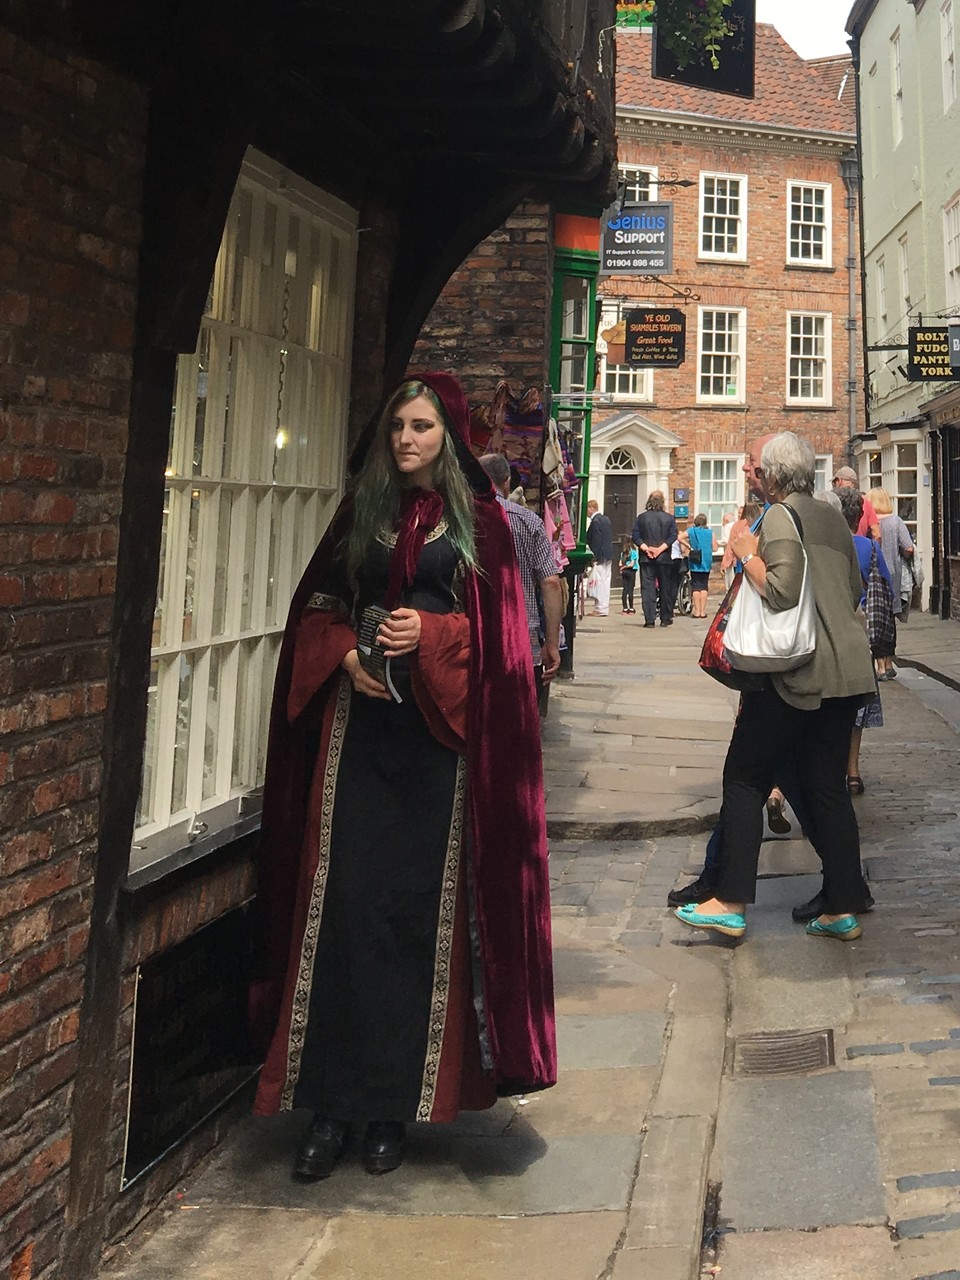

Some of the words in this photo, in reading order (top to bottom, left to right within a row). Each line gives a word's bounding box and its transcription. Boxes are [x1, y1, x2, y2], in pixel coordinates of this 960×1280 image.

[615, 230, 666, 244] Support
[607, 259, 631, 267] 01904
[633, 259, 648, 267] 898
[649, 259, 665, 267] 455
[645, 314, 654, 322] YE
[655, 314, 671, 322] OLD
[630, 323, 659, 332] SHAMBLES
[660, 323, 682, 332] TAVERN
[636, 335, 656, 345] Great
[657, 336, 674, 344] Food
[920, 367, 954, 376] YORK
